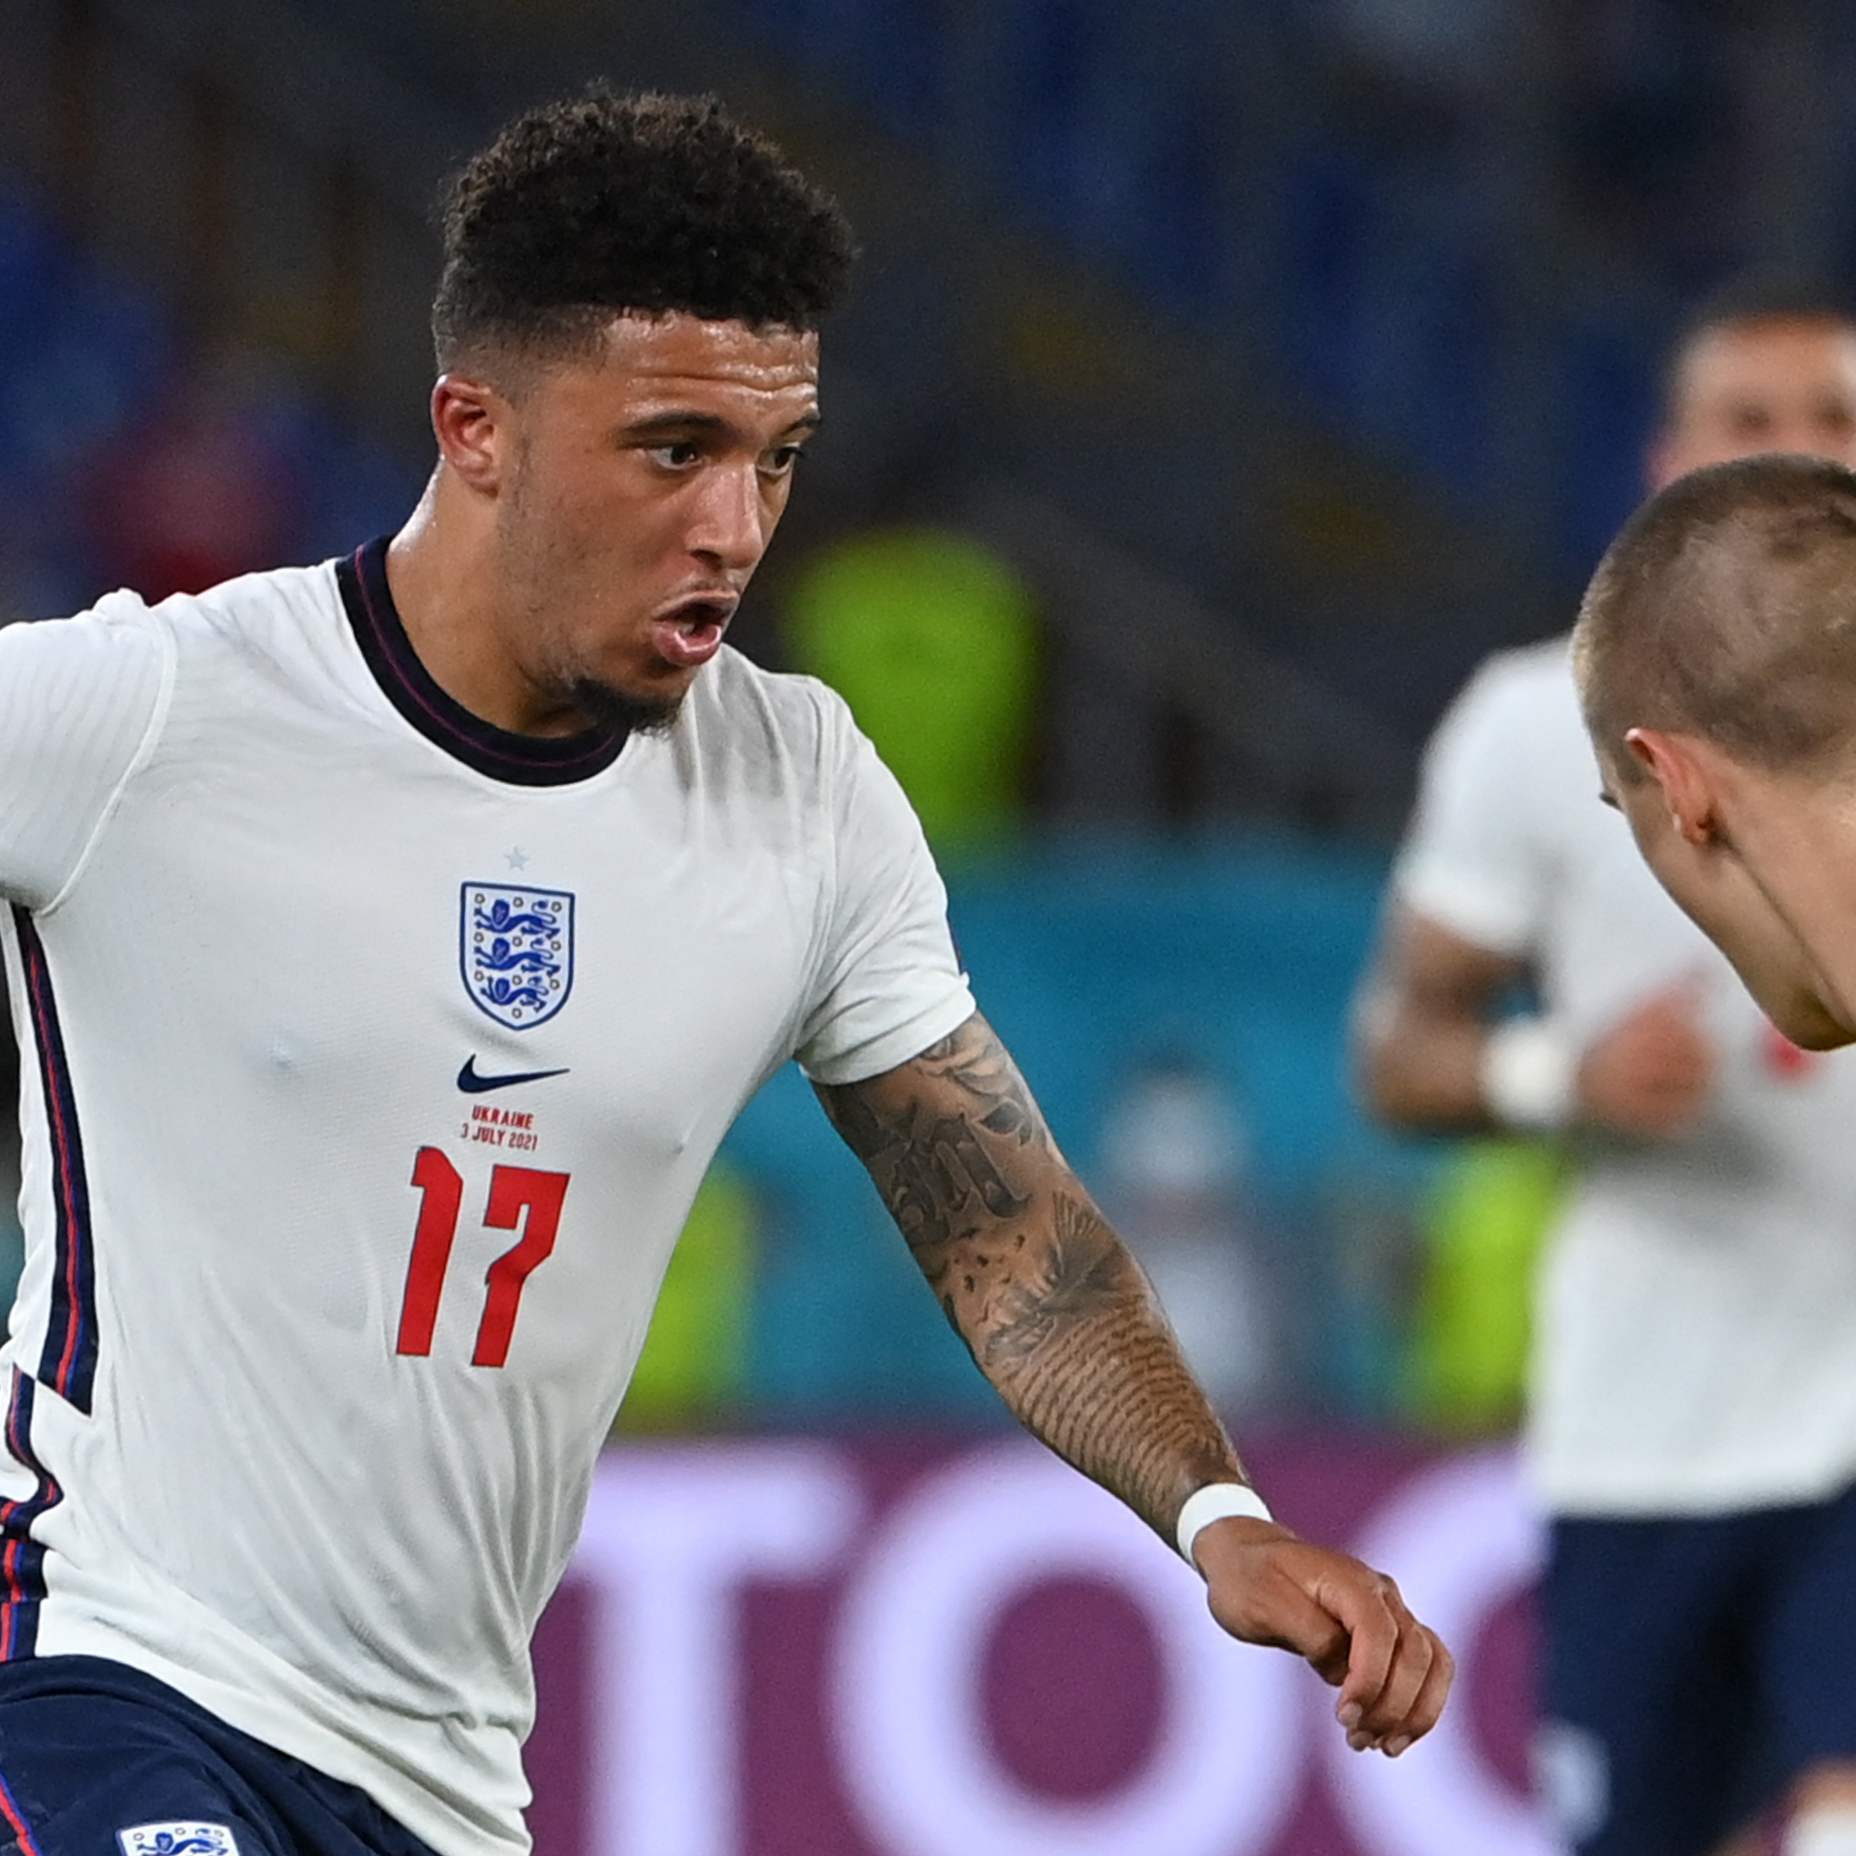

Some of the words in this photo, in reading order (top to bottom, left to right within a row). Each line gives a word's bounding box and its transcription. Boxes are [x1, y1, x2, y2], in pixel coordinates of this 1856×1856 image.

[472, 1104, 534, 1130] UKRAINE
[461, 1122, 469, 1139] 3
[472, 1126, 505, 1147] JULY
[508, 1132, 538, 1151] 2021
[396, 1145, 571, 1368] 17
